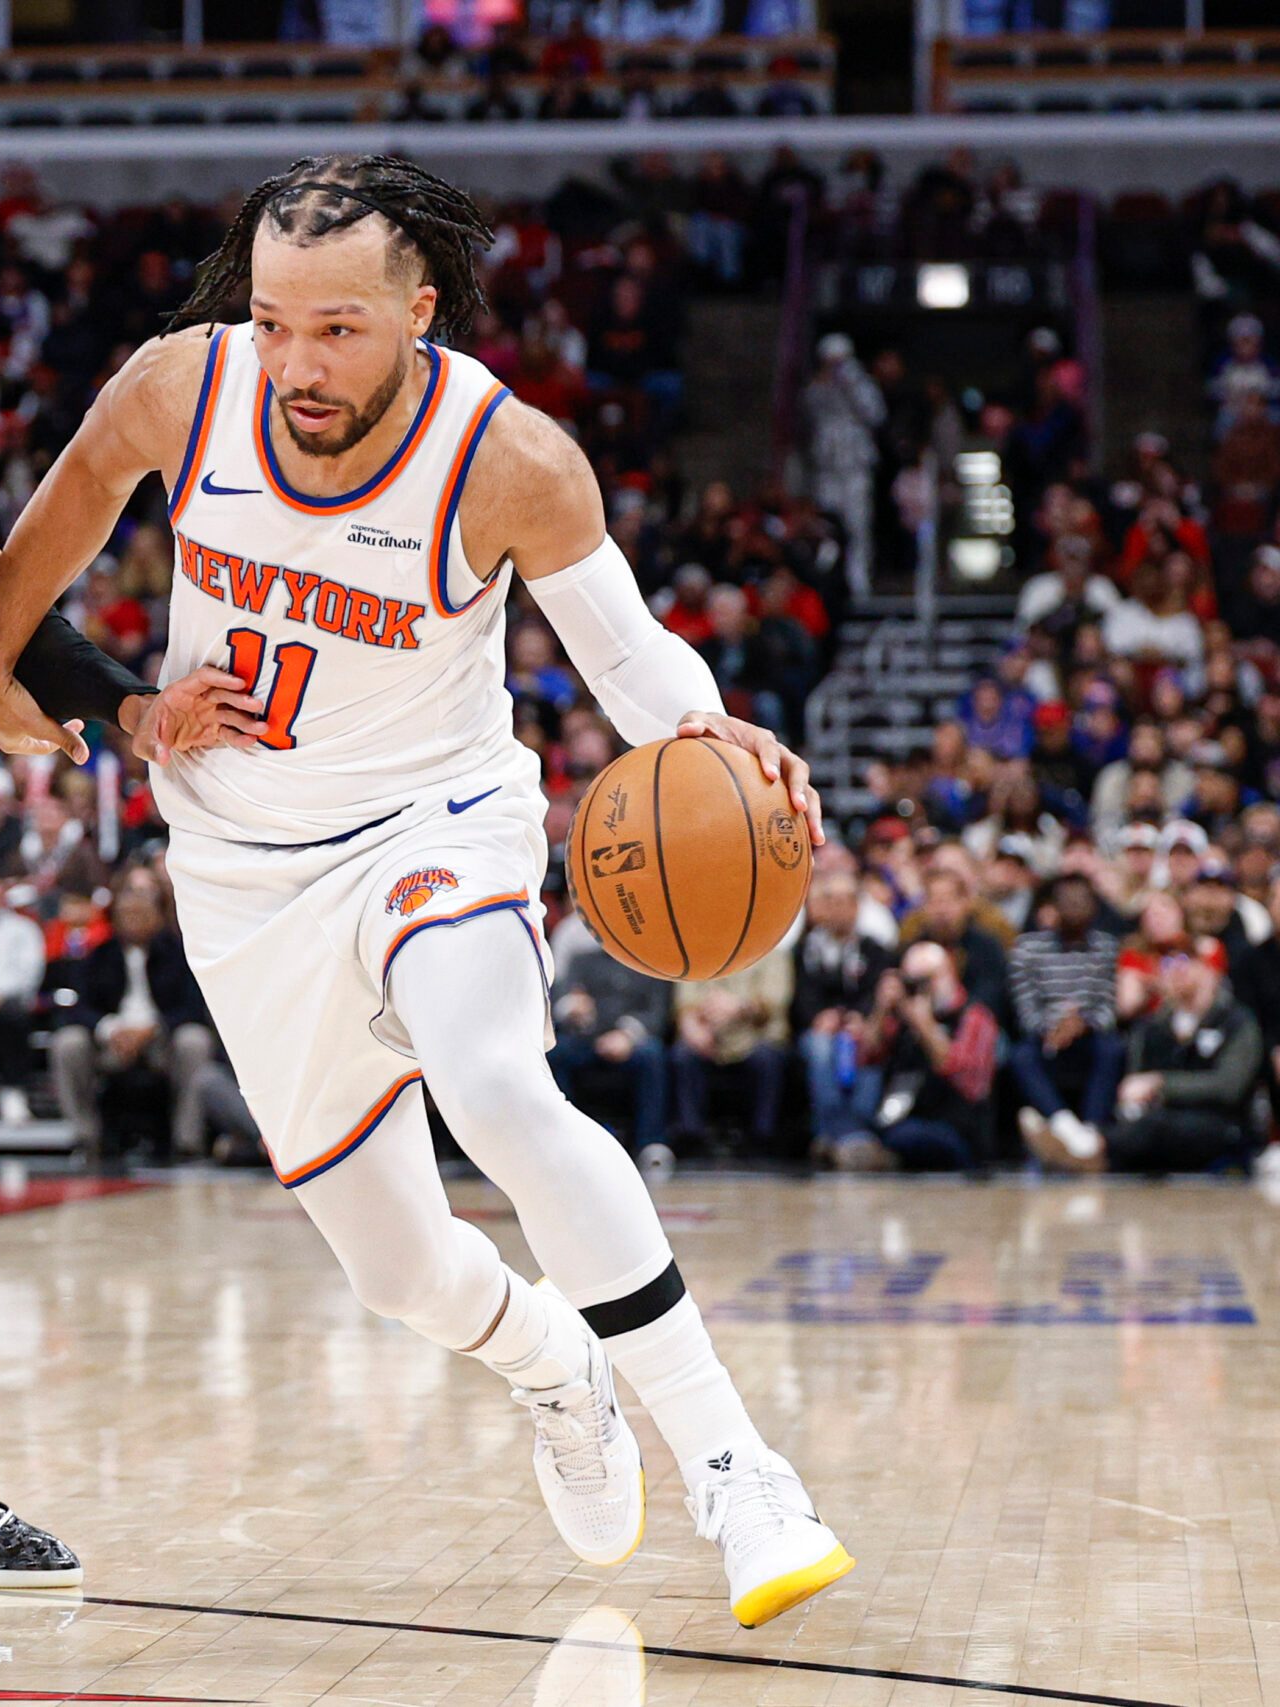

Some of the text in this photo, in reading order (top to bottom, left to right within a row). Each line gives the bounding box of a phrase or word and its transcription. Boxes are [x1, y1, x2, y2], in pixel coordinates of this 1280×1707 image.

[347, 532, 423, 551] abu dhabi
[350, 524, 391, 536] experience
[177, 531, 428, 650] NEW YORK
[226, 627, 318, 751] 11
[384, 868, 459, 915] KNICKS
